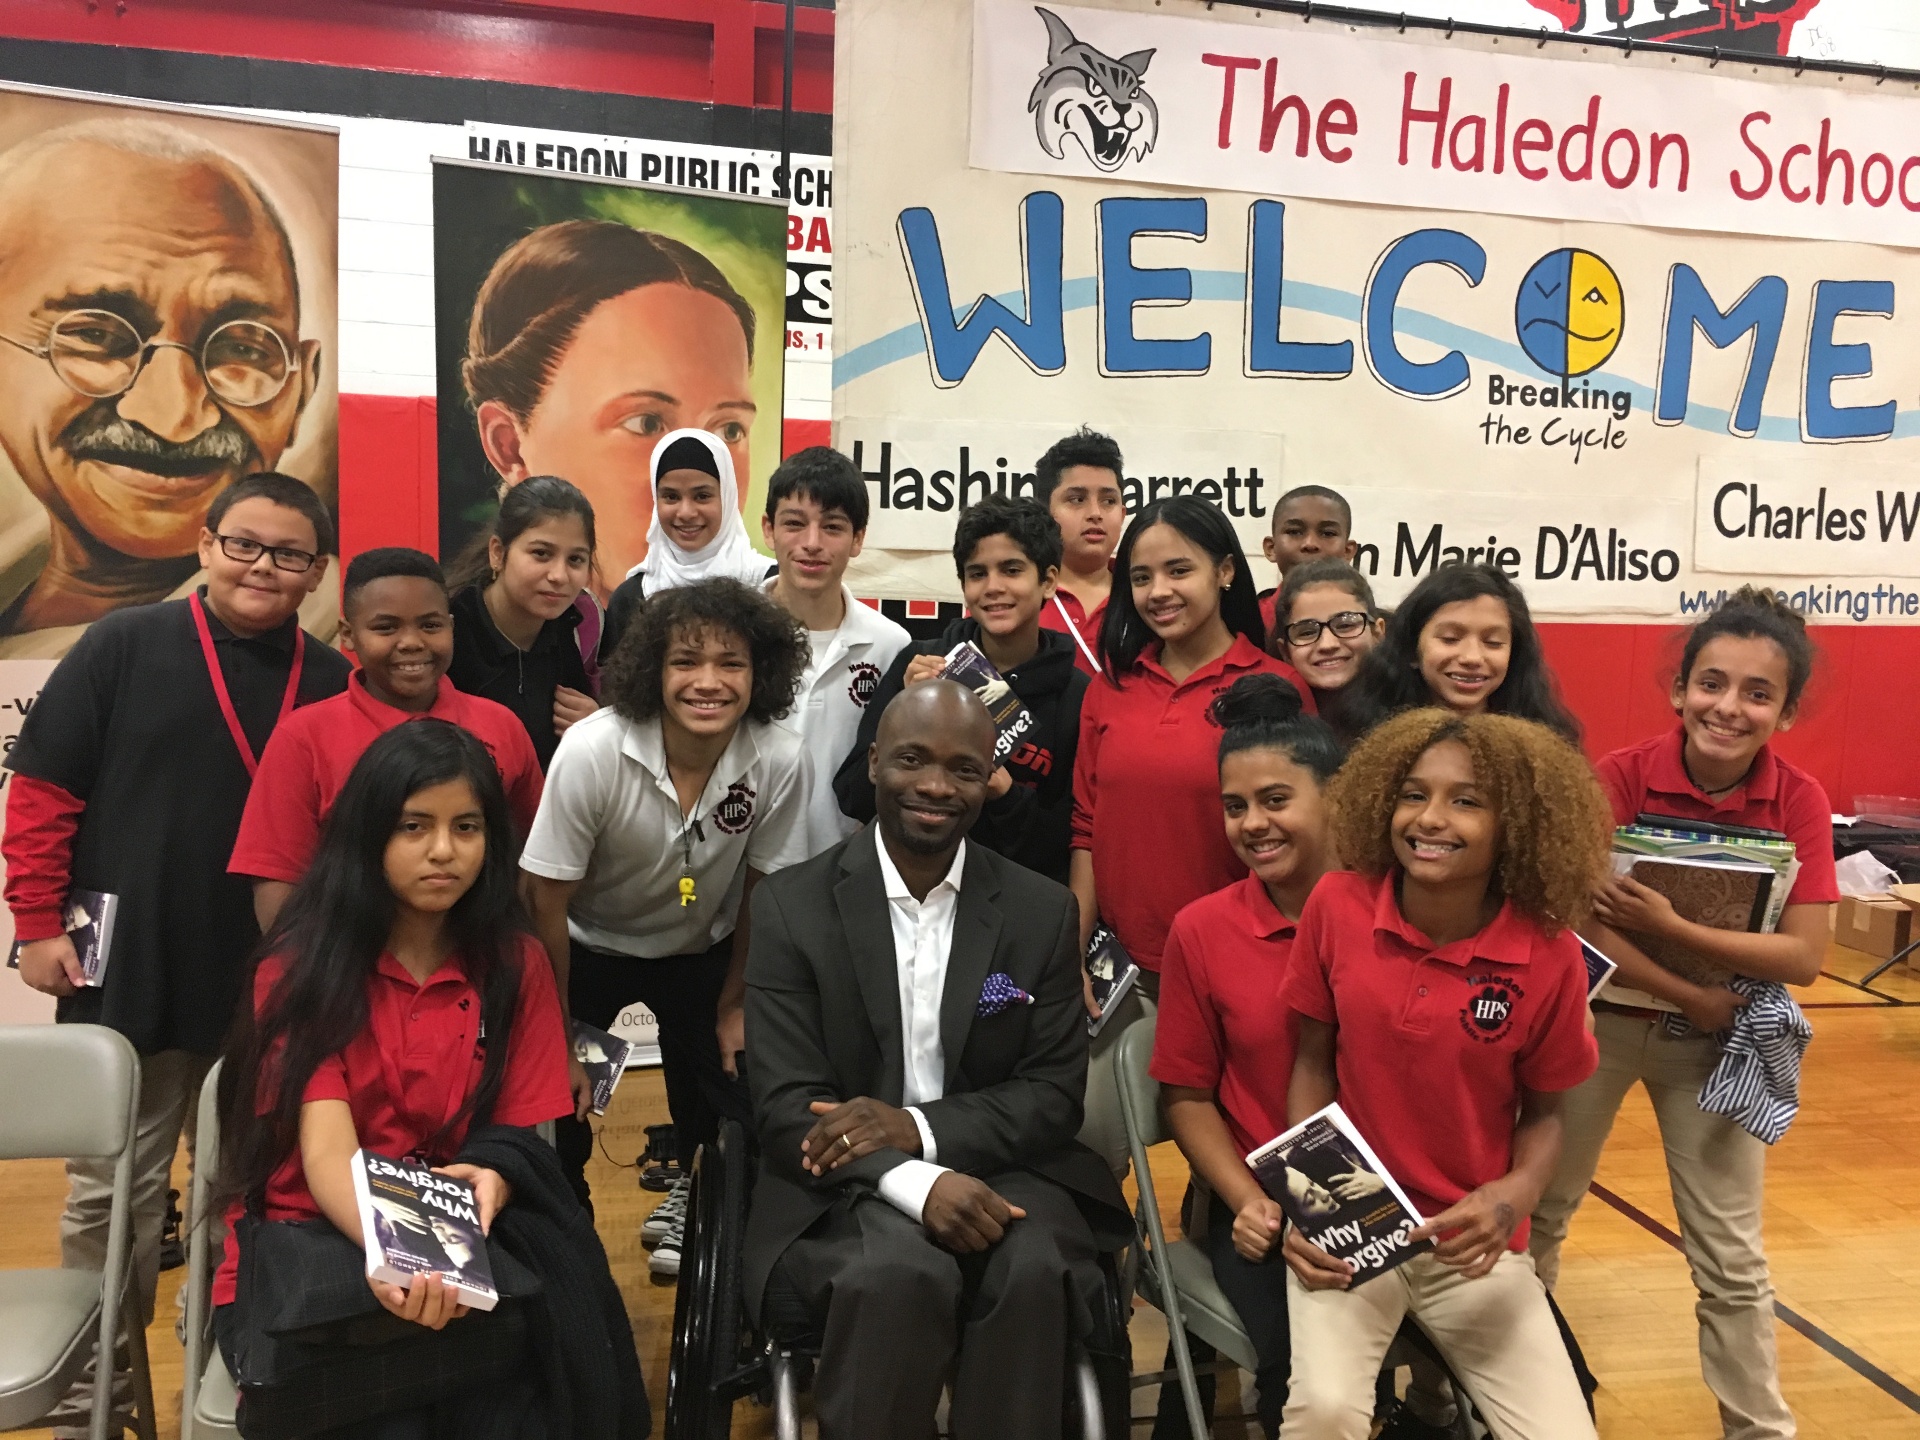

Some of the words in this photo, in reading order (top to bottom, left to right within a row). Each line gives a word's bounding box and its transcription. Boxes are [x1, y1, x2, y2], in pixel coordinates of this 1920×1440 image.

[1202, 52, 1358, 164] The
[1399, 71, 1690, 193] Haledon
[1489, 375, 1631, 420] Breaking
[1479, 412, 1532, 445] the
[1541, 417, 1627, 464] Cycle
[1123, 466, 1266, 519] arrett
[1714, 482, 1867, 542] Charles
[1393, 522, 1521, 577] Marie
[1536, 524, 1680, 583] D'Aliso
[724, 801, 748, 819] HPS
[1474, 999, 1510, 1020] HPS
[367, 1158, 475, 1206] Forgive?
[421, 1190, 479, 1225] Why
[1309, 1215, 1364, 1253] Why
[1343, 1219, 1416, 1272] orgive?
